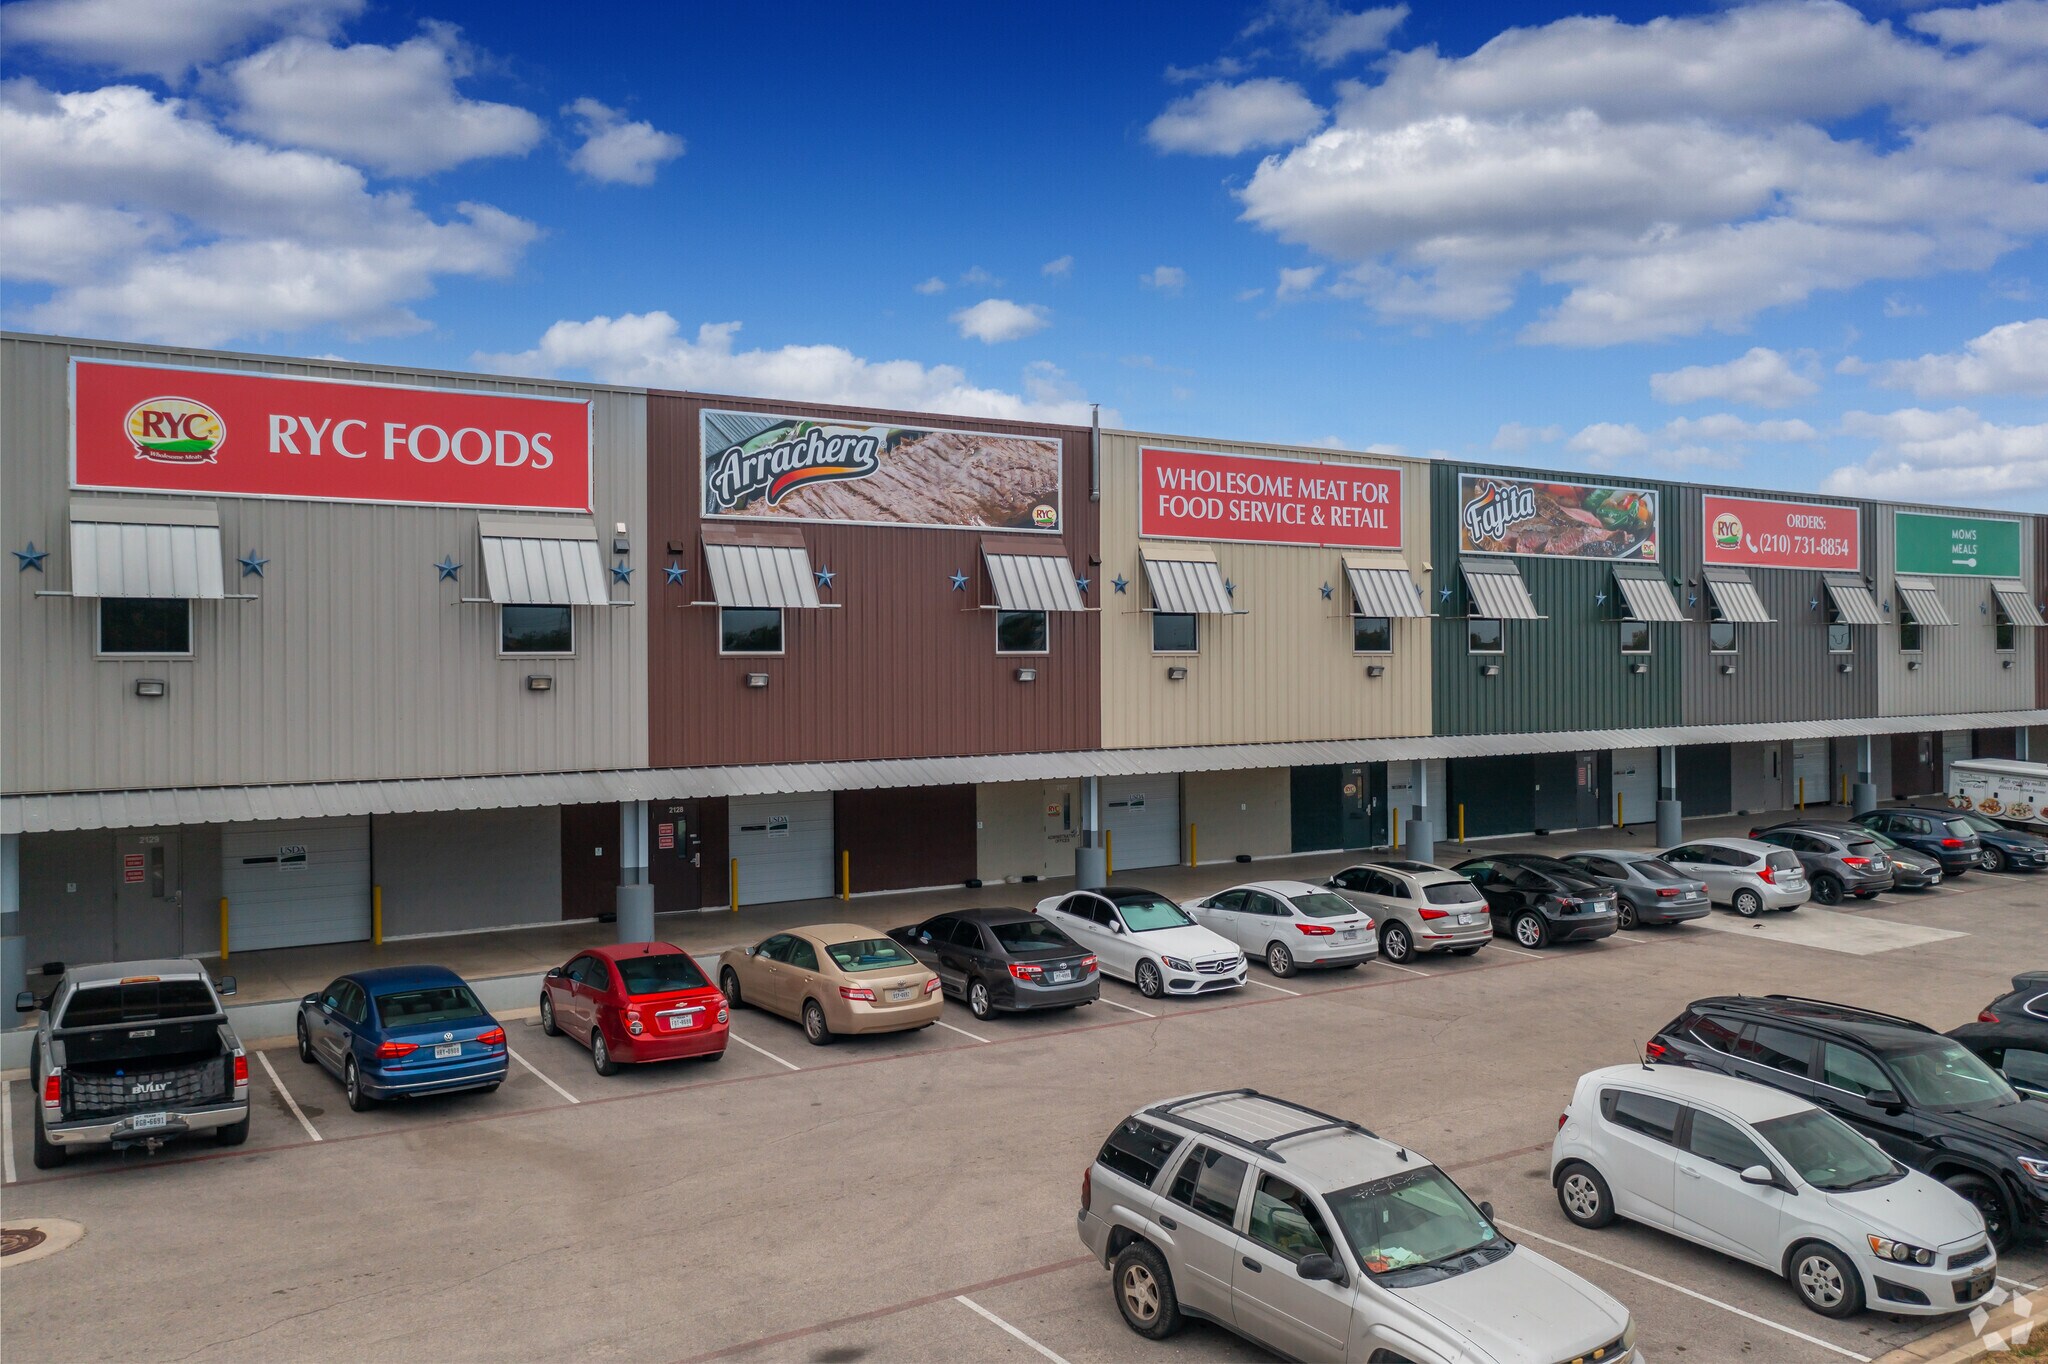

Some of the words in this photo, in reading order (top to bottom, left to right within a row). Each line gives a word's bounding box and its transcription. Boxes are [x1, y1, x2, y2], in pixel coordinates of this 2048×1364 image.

[143, 410, 209, 441] RYC
[269, 413, 368, 459] RYC
[383, 422, 554, 470] FOODS
[150, 450, 185, 460] Wholesome
[713, 429, 877, 502] Arrachera
[1156, 466, 1293, 498] WHOLESOME
[1298, 478, 1348, 501] MEAT
[1353, 482, 1390, 504] FOR
[1036, 509, 1053, 519] RYC
[1159, 494, 1224, 521] FOOD
[1229, 499, 1306, 525] SERVICE
[1310, 505, 1326, 526] &
[1330, 505, 1389, 529] RETAIL
[1466, 485, 1535, 541] Fajita
[1717, 521, 1738, 537] RYC
[1786, 513, 1827, 530] ORDERS:
[1951, 529, 1977, 541] MOM'S
[1759, 533, 1791, 556] (210)
[1794, 536, 1849, 556] 731-8854
[1951, 543, 1977, 555] MEALS
[669, 806, 684, 814] 2128
[139, 835, 160, 844] 2129
[280, 845, 306, 855] USDA
[132, 1081, 167, 1095] BULLY
